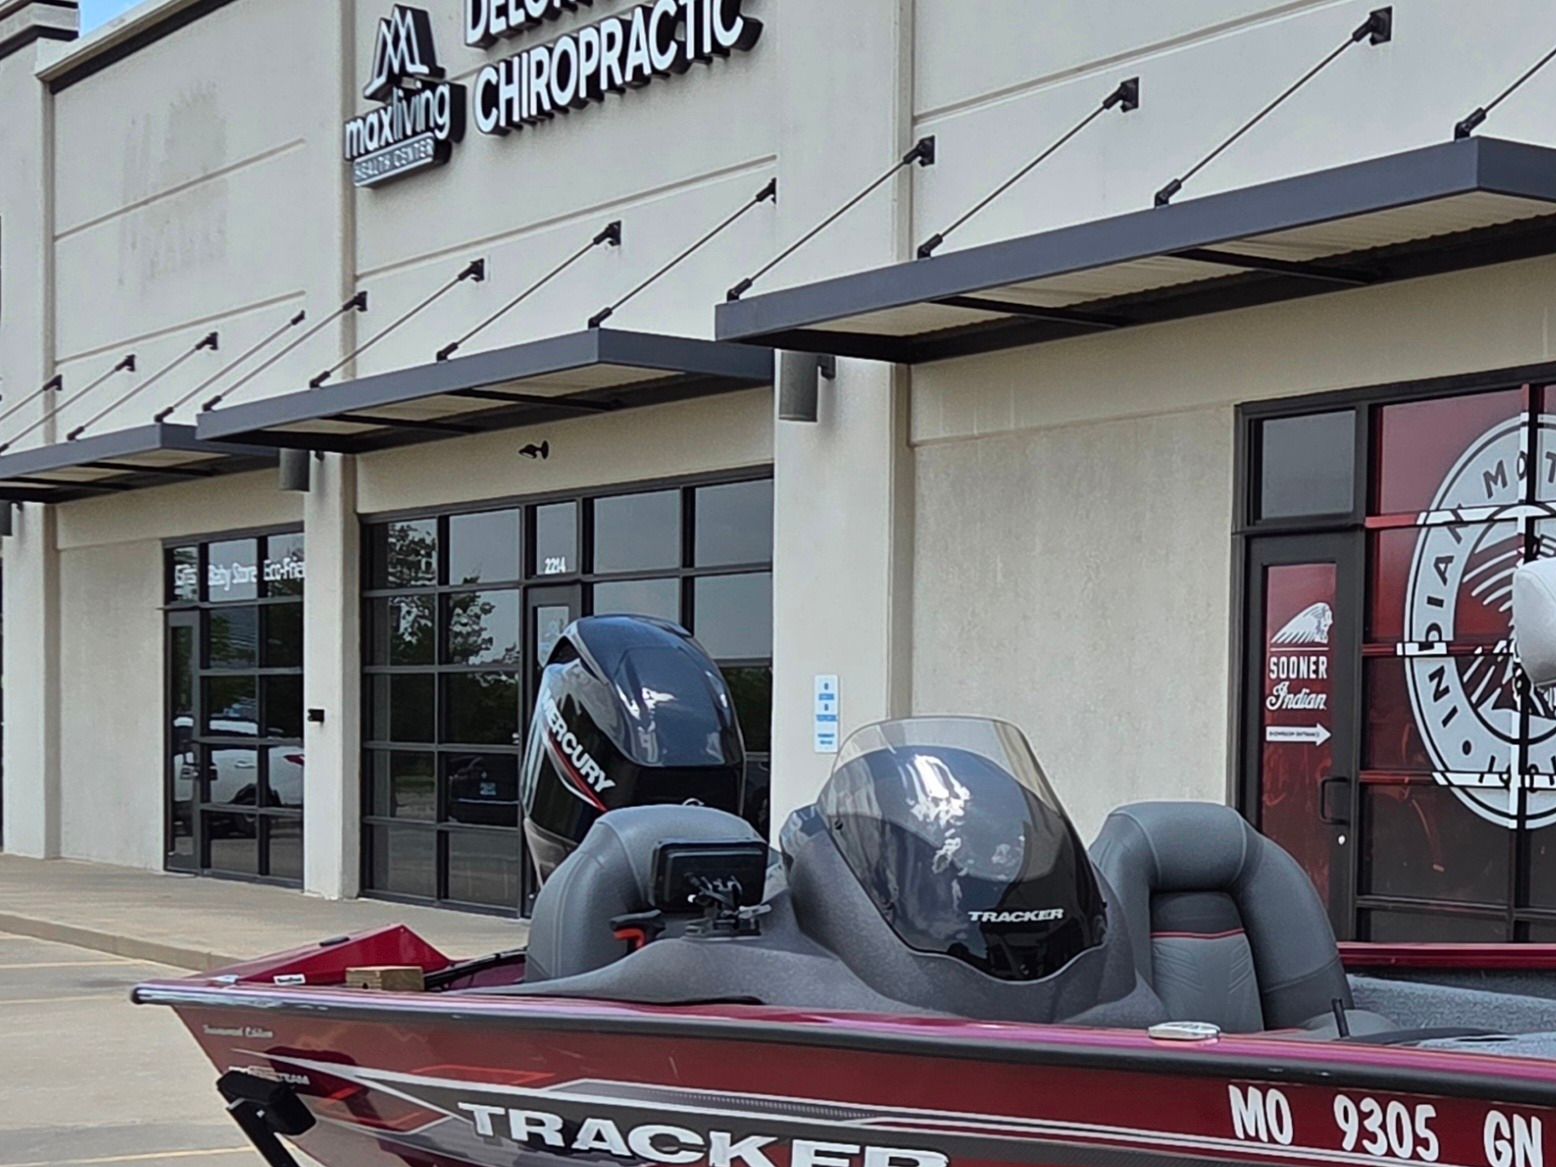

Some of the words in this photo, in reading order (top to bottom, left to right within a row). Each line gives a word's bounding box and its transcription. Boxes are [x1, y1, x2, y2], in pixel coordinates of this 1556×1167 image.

[474, 0, 744, 133] CHIROPRACTIC
[345, 80, 450, 160] maxliving
[1269, 655, 1328, 680] SOONER
[1265, 681, 1328, 711] Indian
[967, 908, 1065, 923] TRACKER
[1228, 1084, 1294, 1146] MO
[1333, 1093, 1440, 1162] 9305
